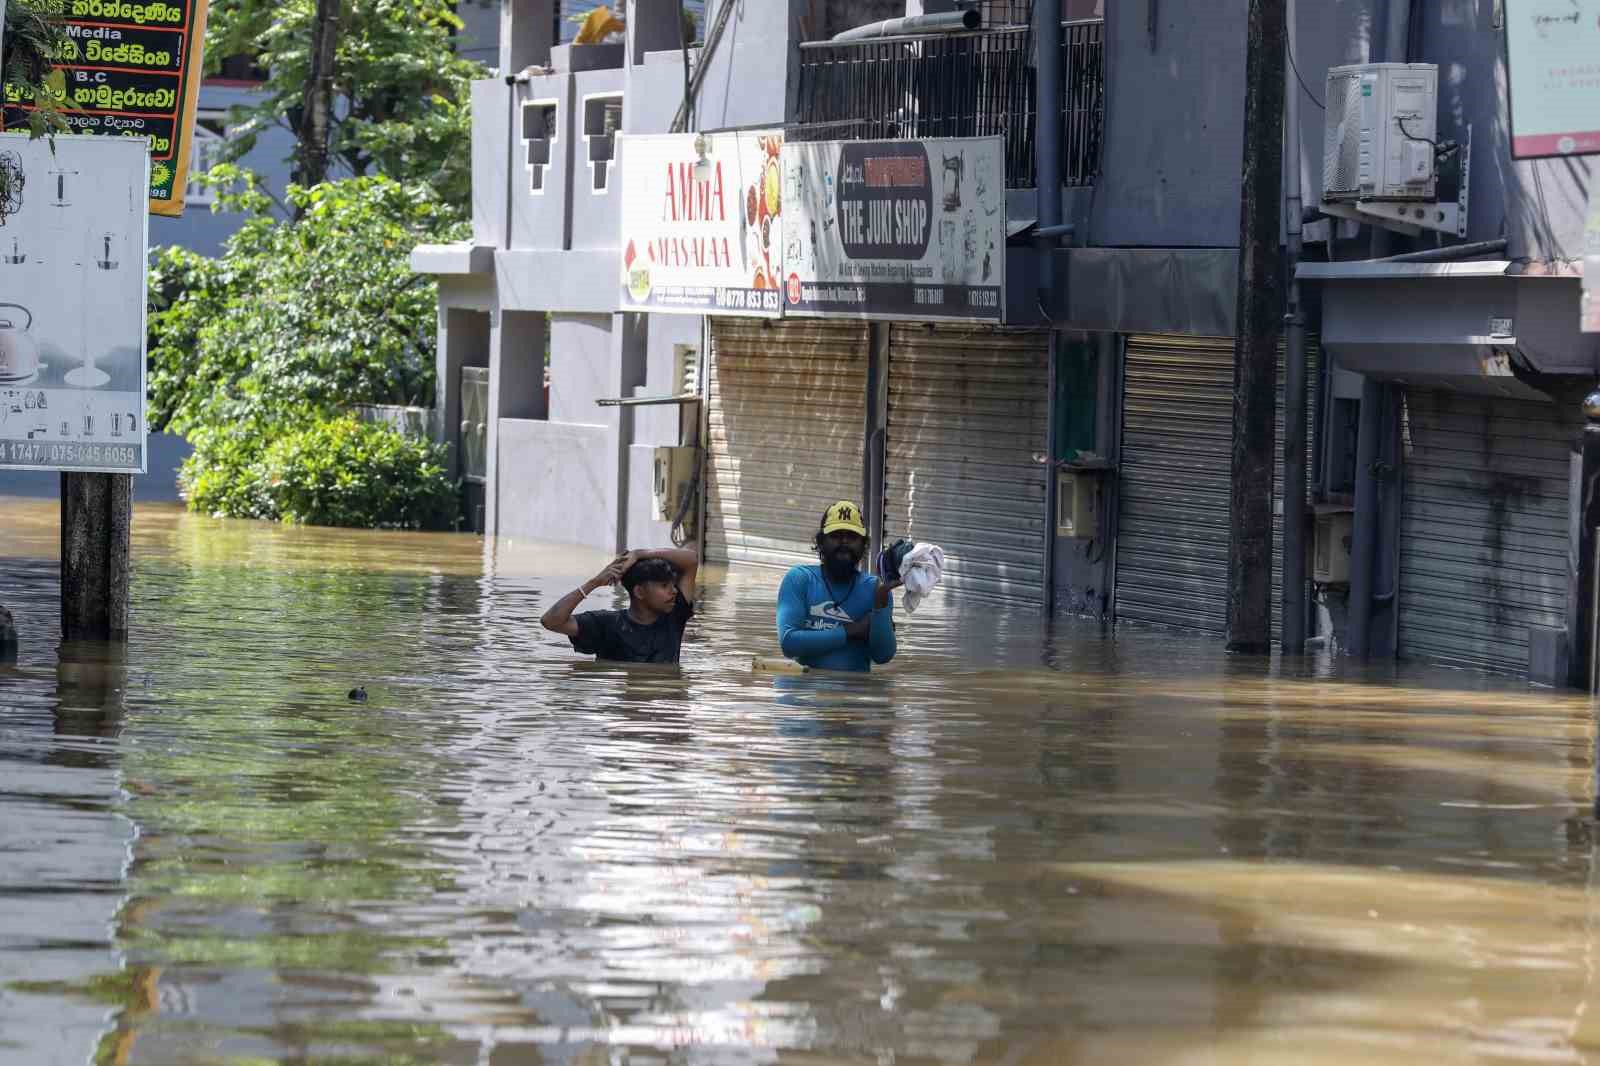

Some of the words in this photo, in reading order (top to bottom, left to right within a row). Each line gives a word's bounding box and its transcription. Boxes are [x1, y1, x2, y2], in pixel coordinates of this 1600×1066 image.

[66, 26, 122, 40] Media
[76, 72, 107, 83] B.C
[663, 161, 725, 221] AMMA
[841, 200, 864, 245] THE
[867, 200, 893, 245] JUKI
[895, 199, 927, 245] SHOP
[657, 237, 731, 268] MASALAA
[10, 444, 40, 460] 1747
